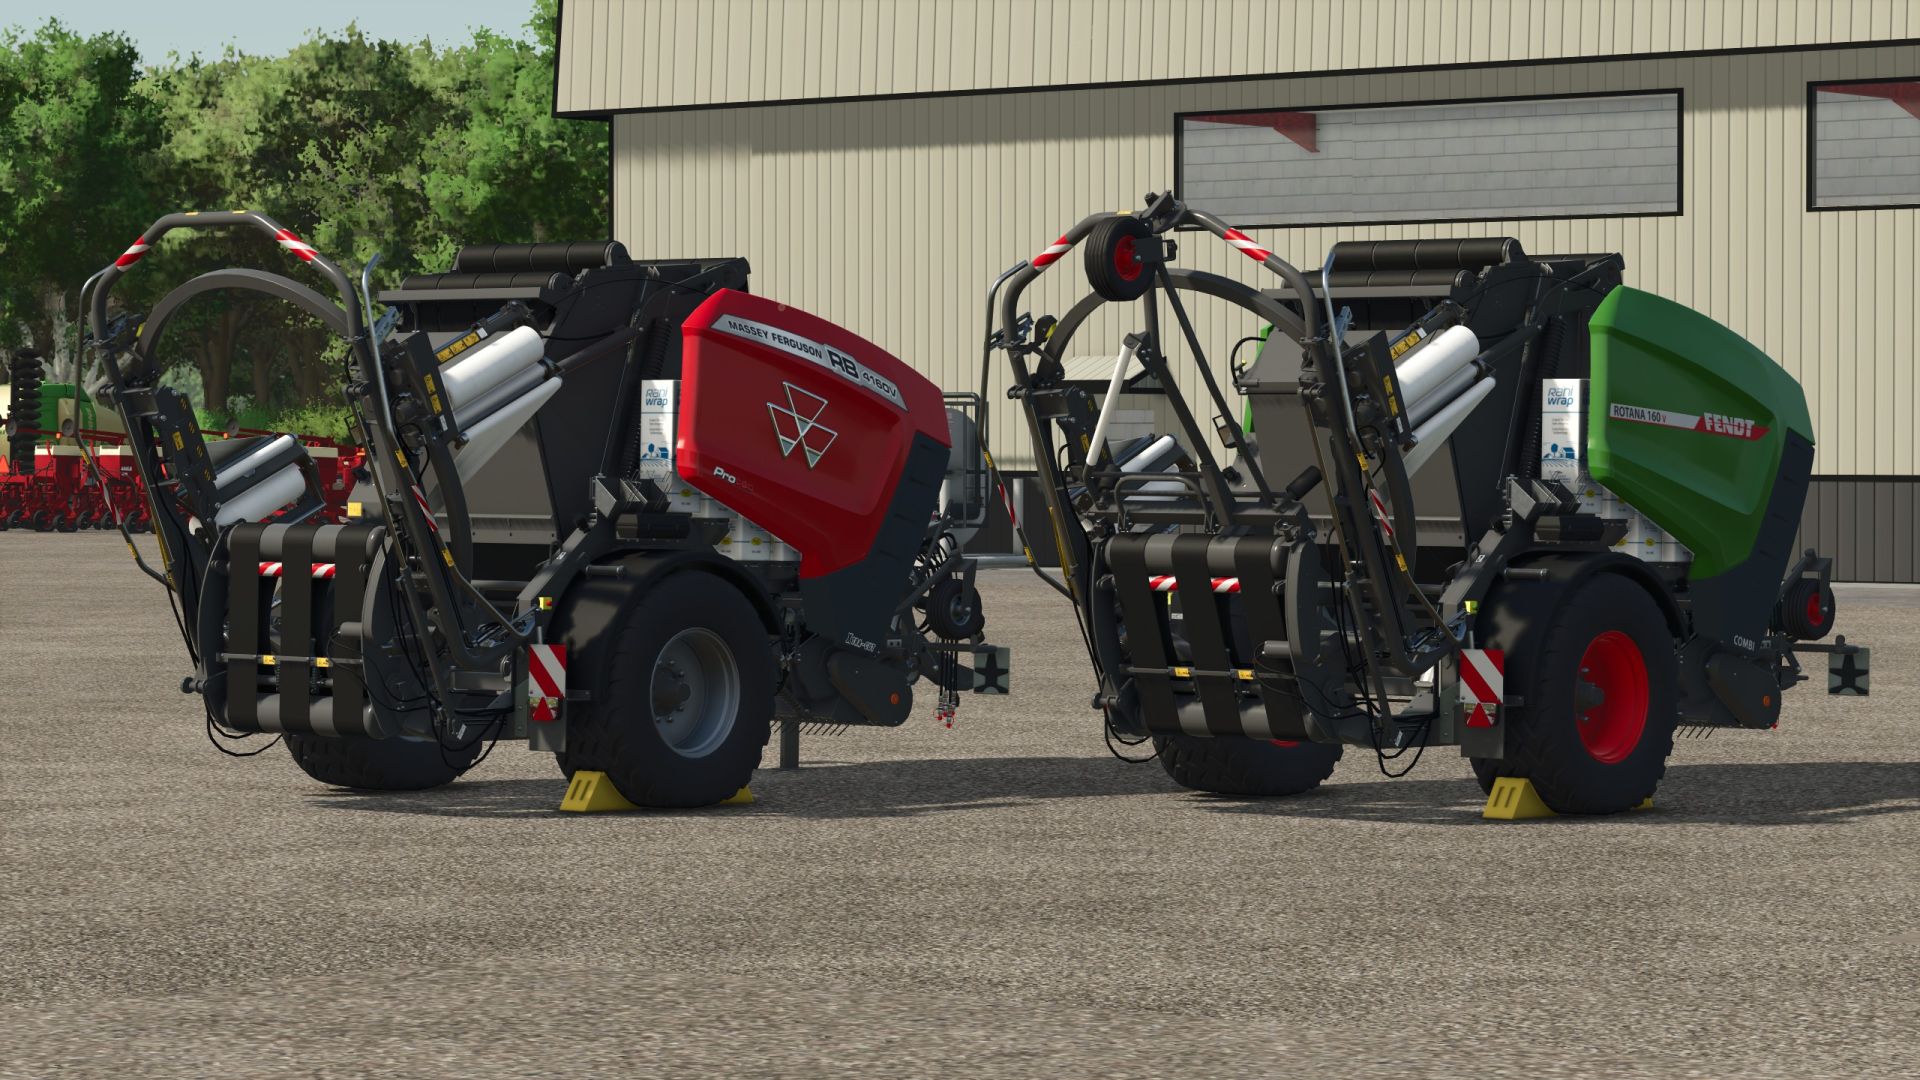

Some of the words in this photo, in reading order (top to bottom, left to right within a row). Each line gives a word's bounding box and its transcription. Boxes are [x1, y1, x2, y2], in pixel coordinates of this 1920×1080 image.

[728, 320, 768, 339] MASSEY
[772, 332, 823, 359] FERGUSON
[827, 350, 859, 379] RB
[862, 371, 897, 398] 4160V
[646, 398, 668, 408] wrap
[1547, 397, 1574, 407] wrap
[1613, 404, 1646, 422] ROTANA
[1647, 410, 1661, 423] 160
[1703, 412, 1755, 437] FENDT
[713, 466, 736, 484] Pro
[1733, 634, 1756, 652] COMBI
